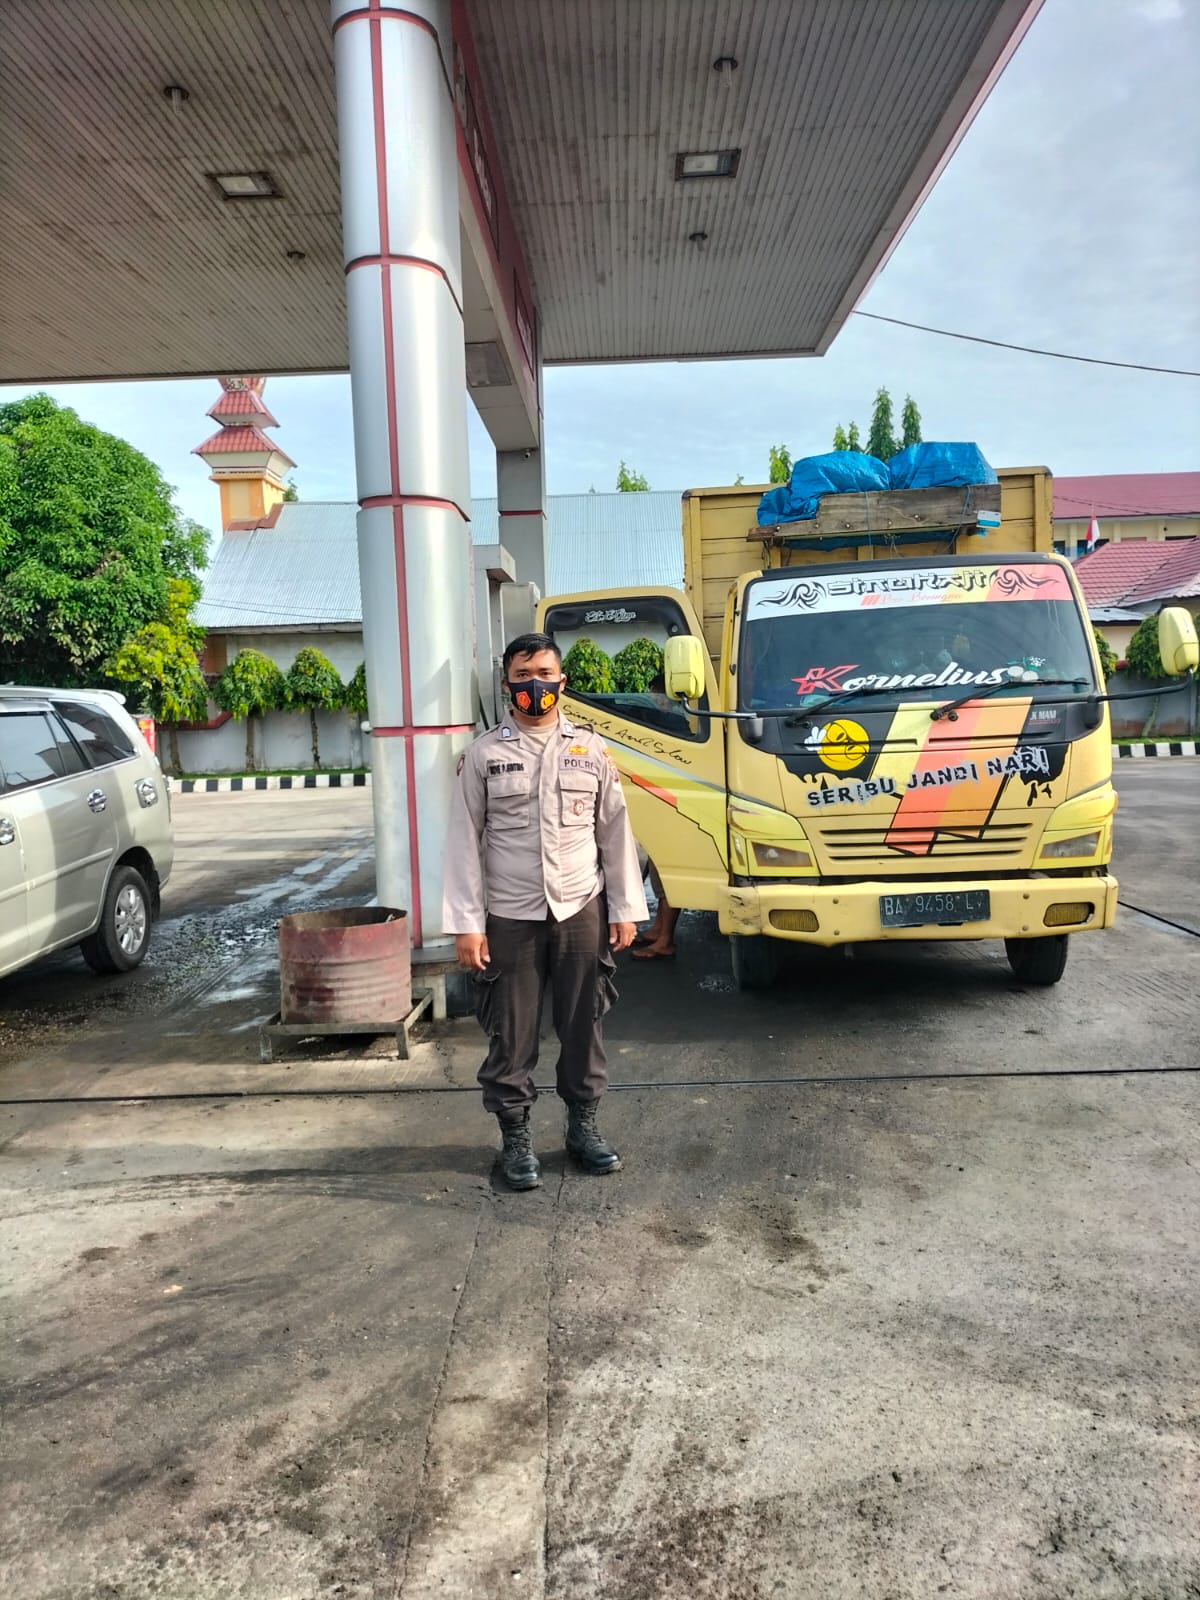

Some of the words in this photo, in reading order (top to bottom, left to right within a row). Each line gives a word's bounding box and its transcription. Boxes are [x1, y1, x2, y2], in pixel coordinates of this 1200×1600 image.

[791, 661, 1010, 695] Kornelius
[564, 758, 595, 771] POLRI
[807, 778, 895, 806] SERIBU
[907, 763, 979, 789] JANDI
[987, 748, 1048, 776] NARI
[915, 893, 955, 913] 9458
